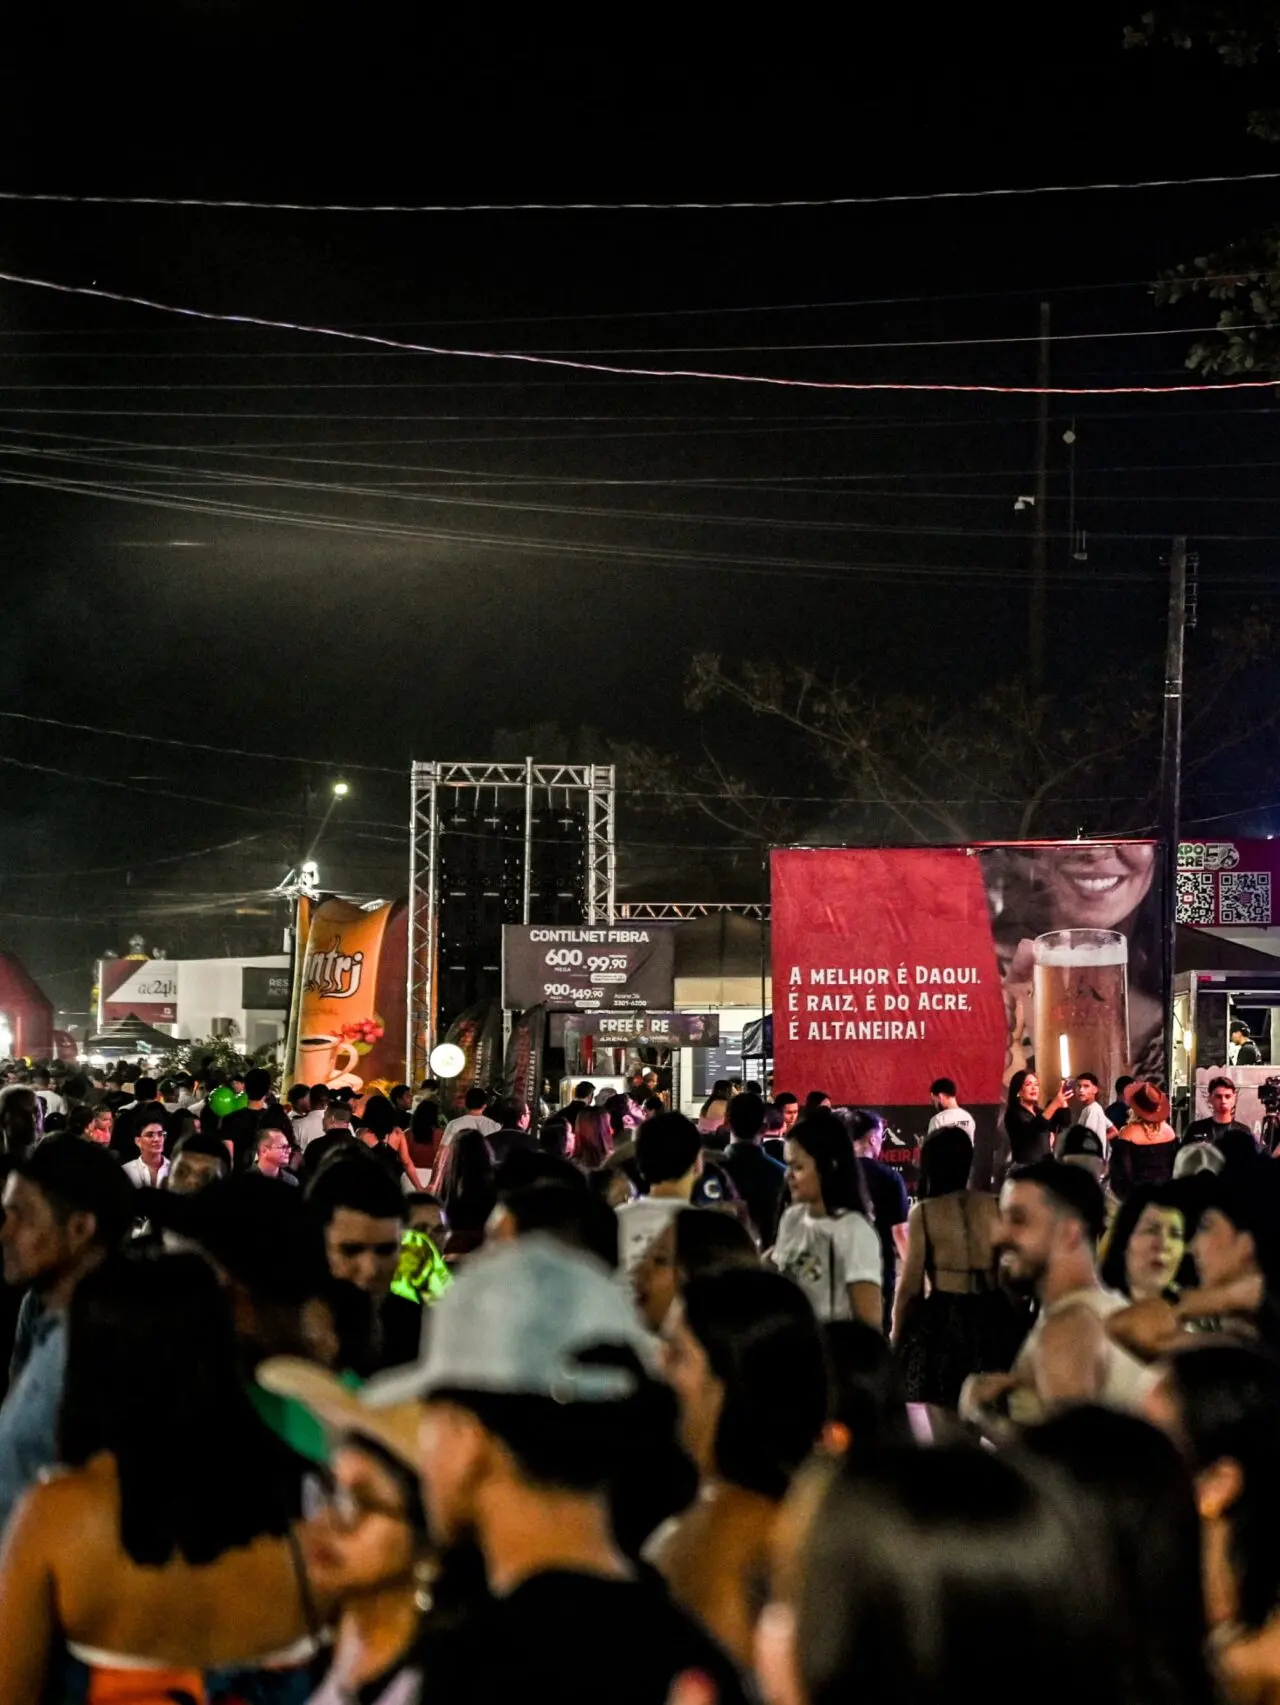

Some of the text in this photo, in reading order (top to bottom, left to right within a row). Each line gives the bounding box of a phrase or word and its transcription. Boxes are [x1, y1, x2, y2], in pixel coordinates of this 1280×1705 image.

[530, 930, 650, 943] CONTILNET FIBRA
[545, 949, 583, 966] 600
[789, 962, 981, 985] A MELHOR É DAQUI.
[544, 984, 570, 995] 900
[788, 987, 972, 1013] É RAIZ, É DO ACRE,
[599, 1019, 633, 1033] FREE
[789, 1015, 925, 1040] É ALTANEIRA!
